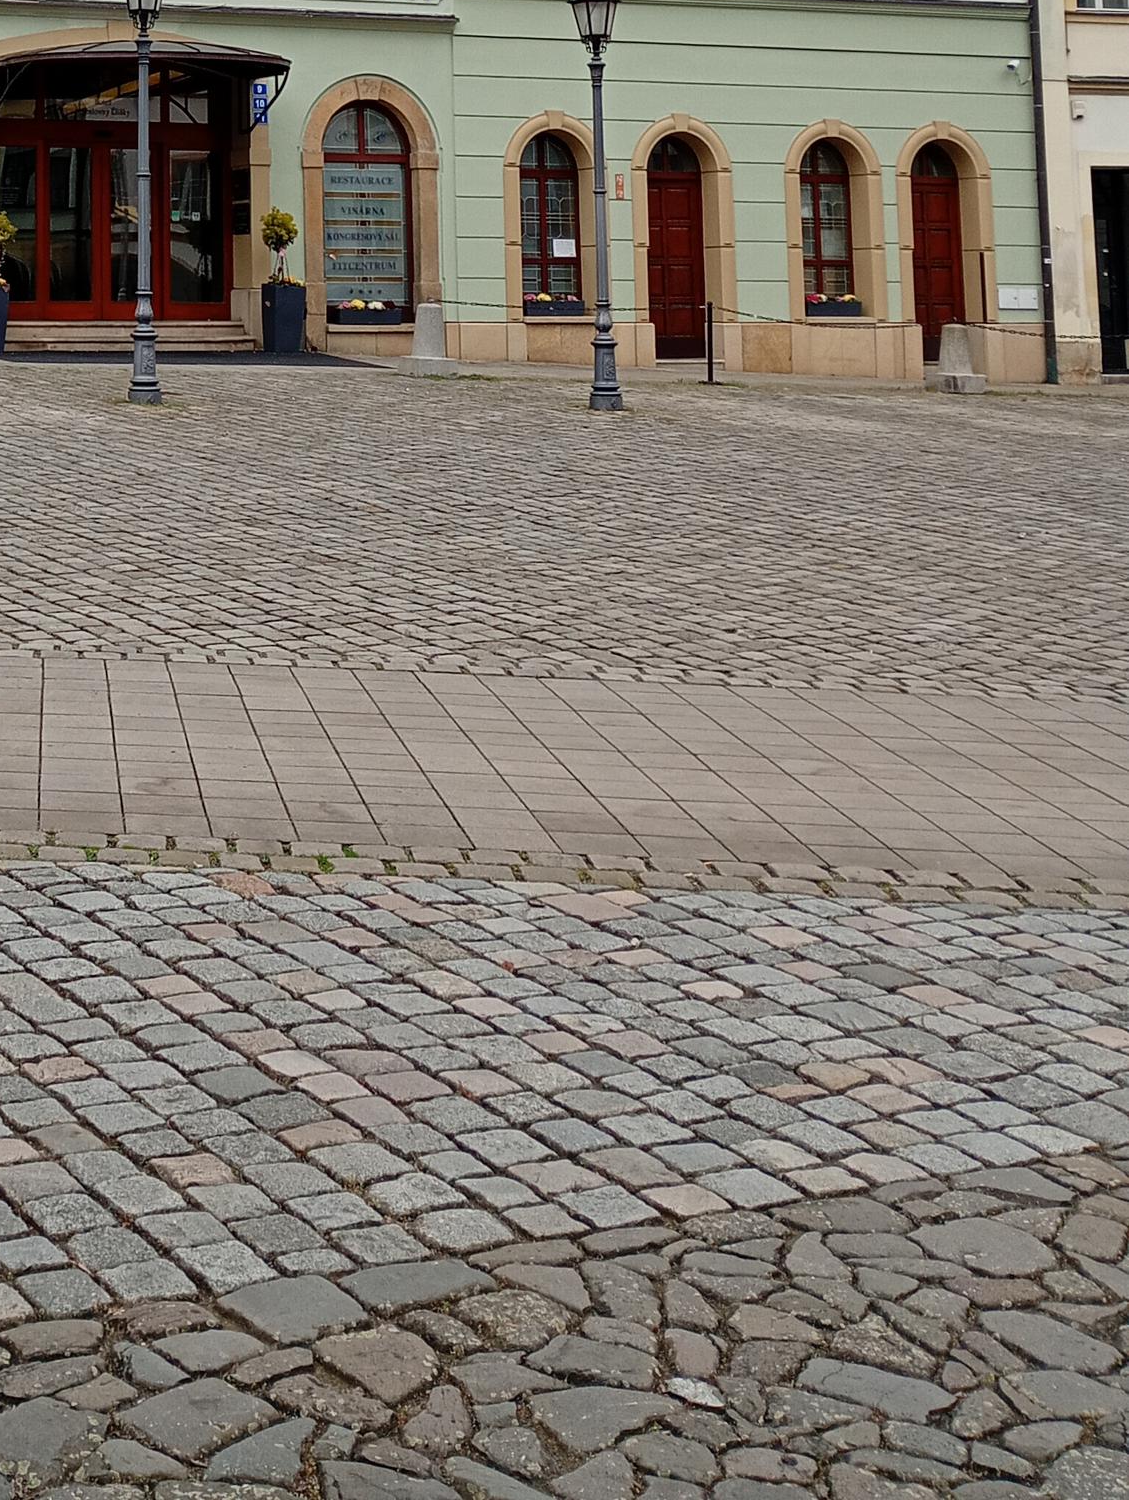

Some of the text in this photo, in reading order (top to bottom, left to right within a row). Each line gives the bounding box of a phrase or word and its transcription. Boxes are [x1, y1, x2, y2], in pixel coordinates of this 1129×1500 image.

[257, 85, 263, 93] 9
[255, 100, 265, 108] 10
[331, 175, 393, 185] RESTAURACE
[341, 204, 385, 216] VINÁRNA
[332, 261, 396, 271] FITCENTRUM
